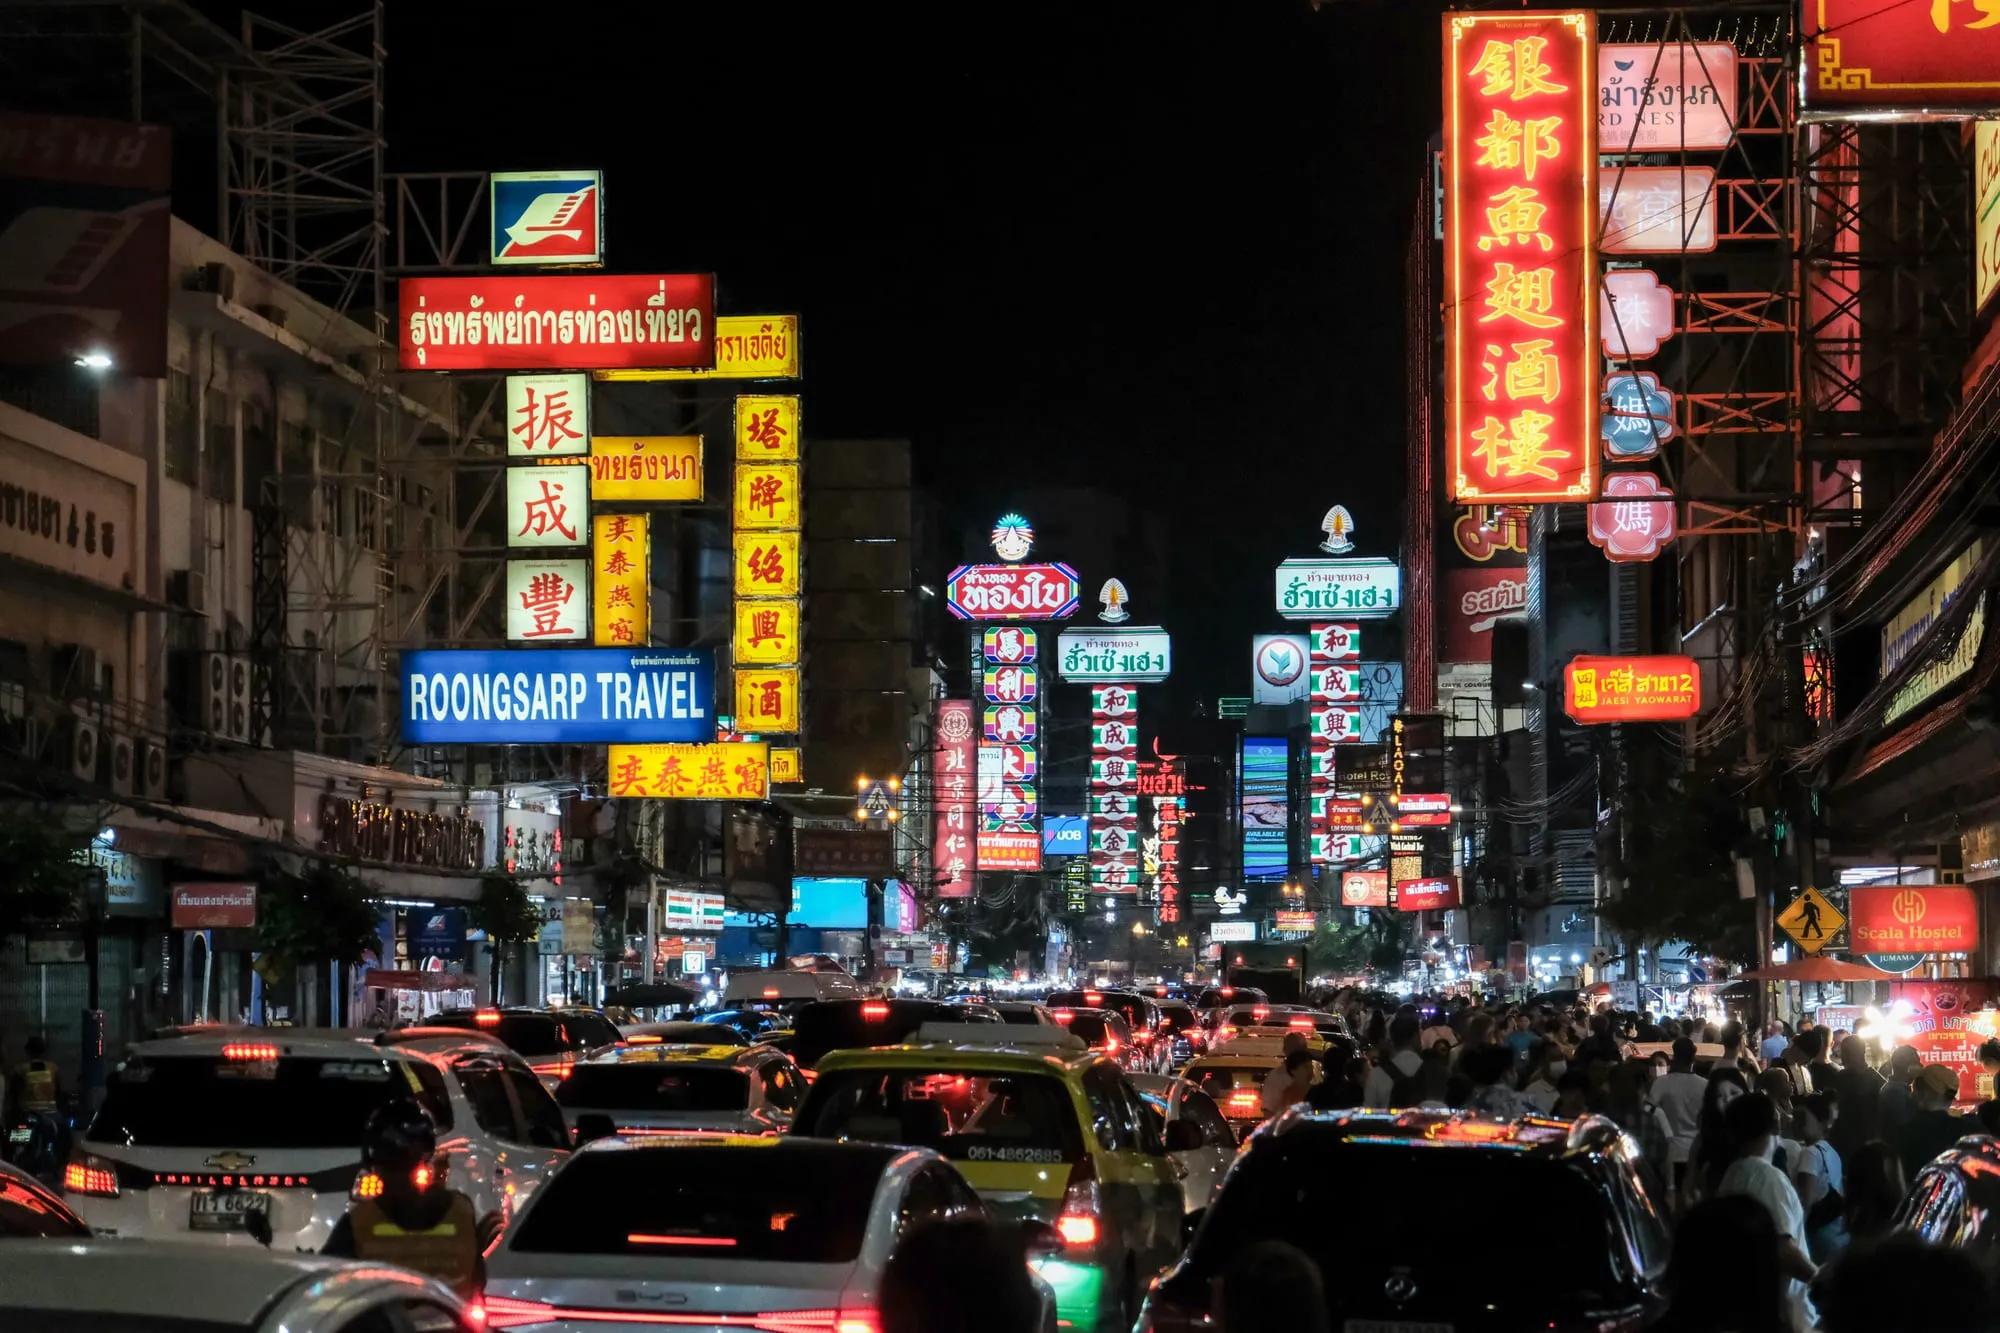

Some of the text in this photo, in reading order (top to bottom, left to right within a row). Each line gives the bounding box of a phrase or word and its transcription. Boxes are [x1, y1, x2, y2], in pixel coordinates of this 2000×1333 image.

[1468, 36, 1570, 480] 銀都魚翅酒樓
[409, 280, 702, 365] รุ่งทรัพย์การท่องเที่ยว
[411, 671, 705, 721] ROONGSARP TRAVEL
[1634, 695, 1693, 704] YAOWARAT
[1057, 830, 1082, 840] UOB
[1858, 925, 1963, 940] Scala Hostel
